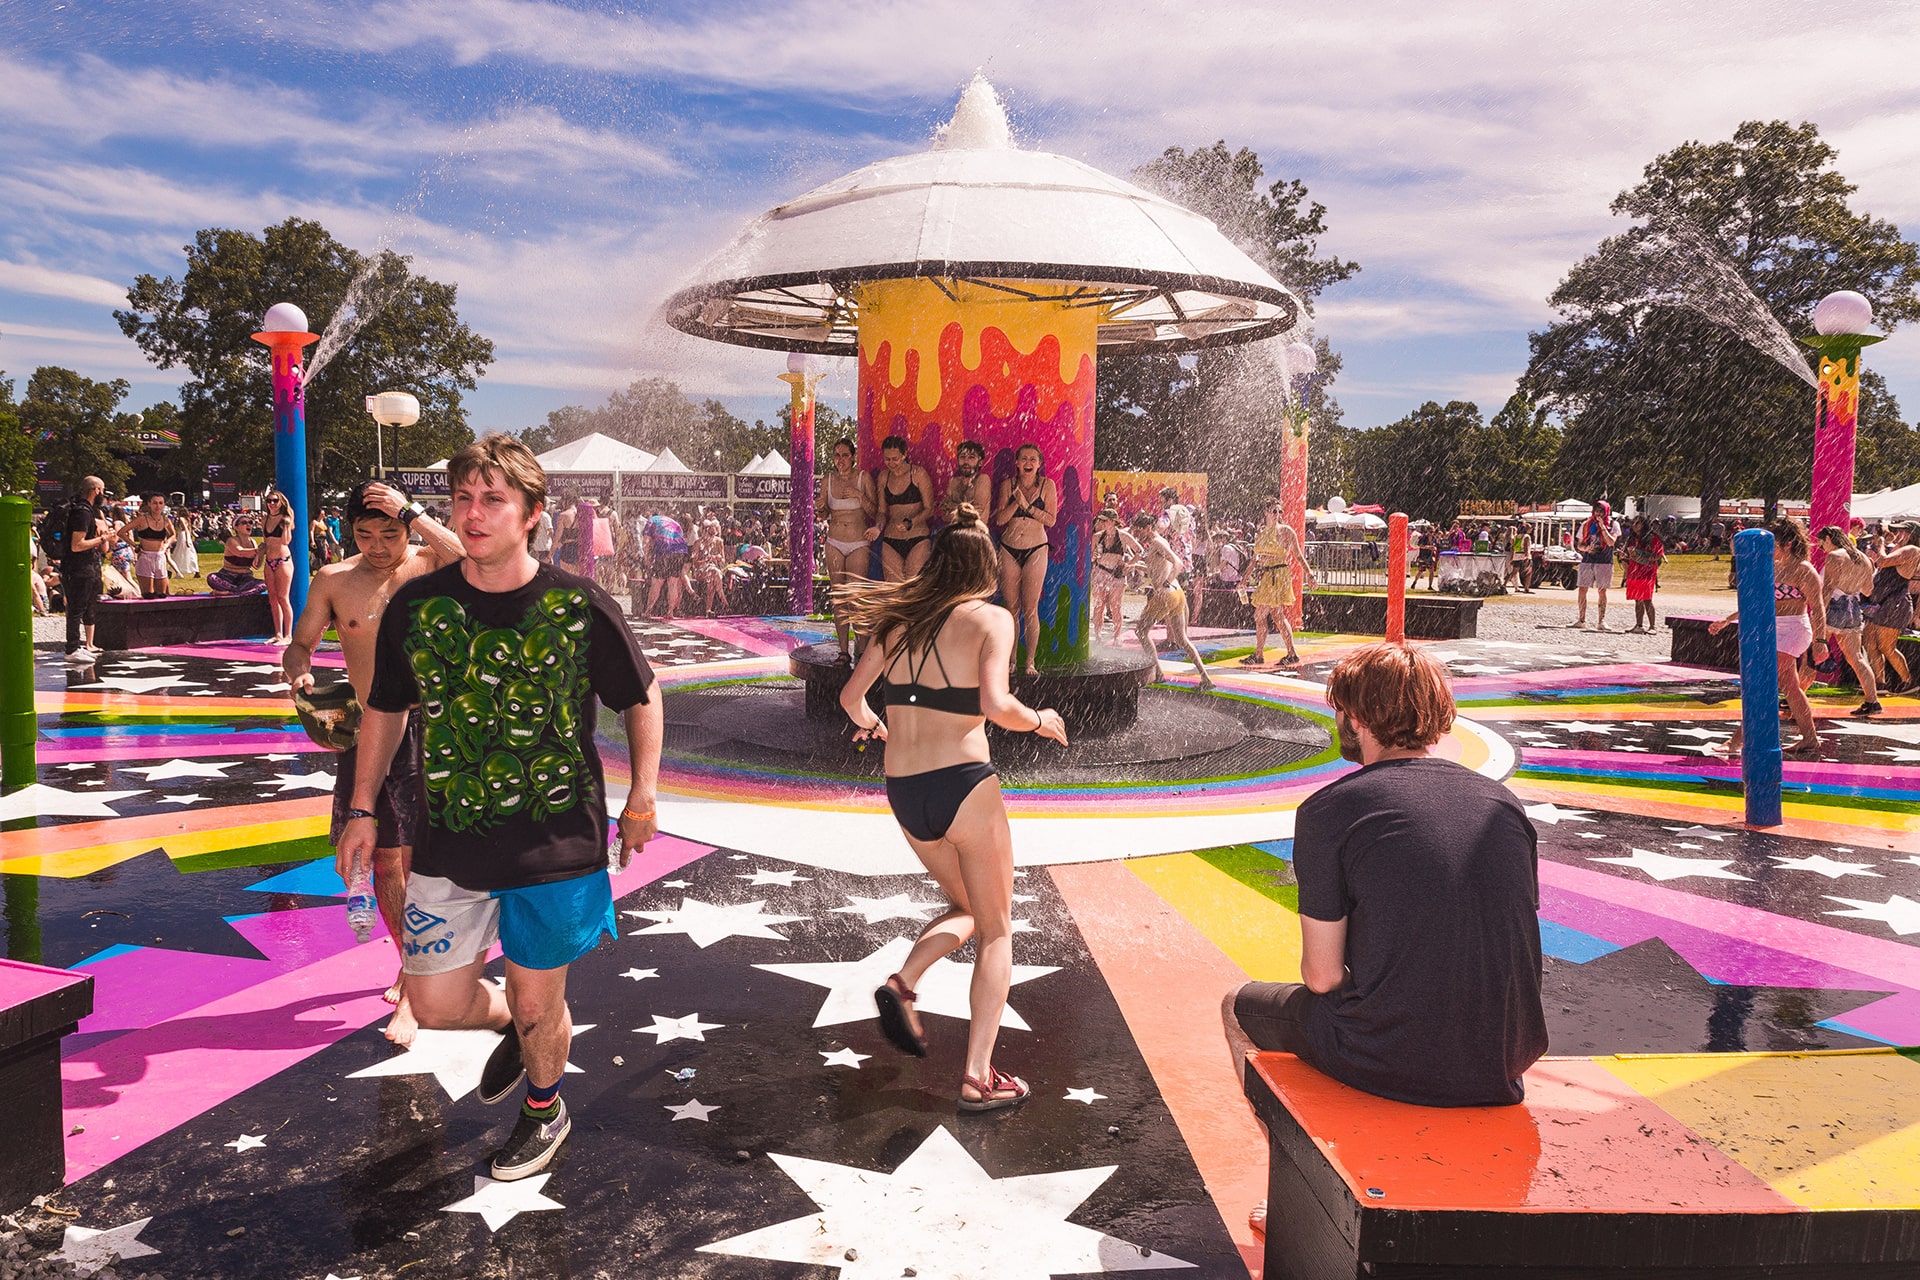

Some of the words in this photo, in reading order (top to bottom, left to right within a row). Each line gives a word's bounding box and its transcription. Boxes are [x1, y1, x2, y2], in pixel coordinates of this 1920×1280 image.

[433, 473, 450, 486] SAL
[641, 475, 660, 489] BEN
[660, 476, 668, 489] &
[759, 479, 785, 493] CORN
[403, 938, 451, 956] mbro
